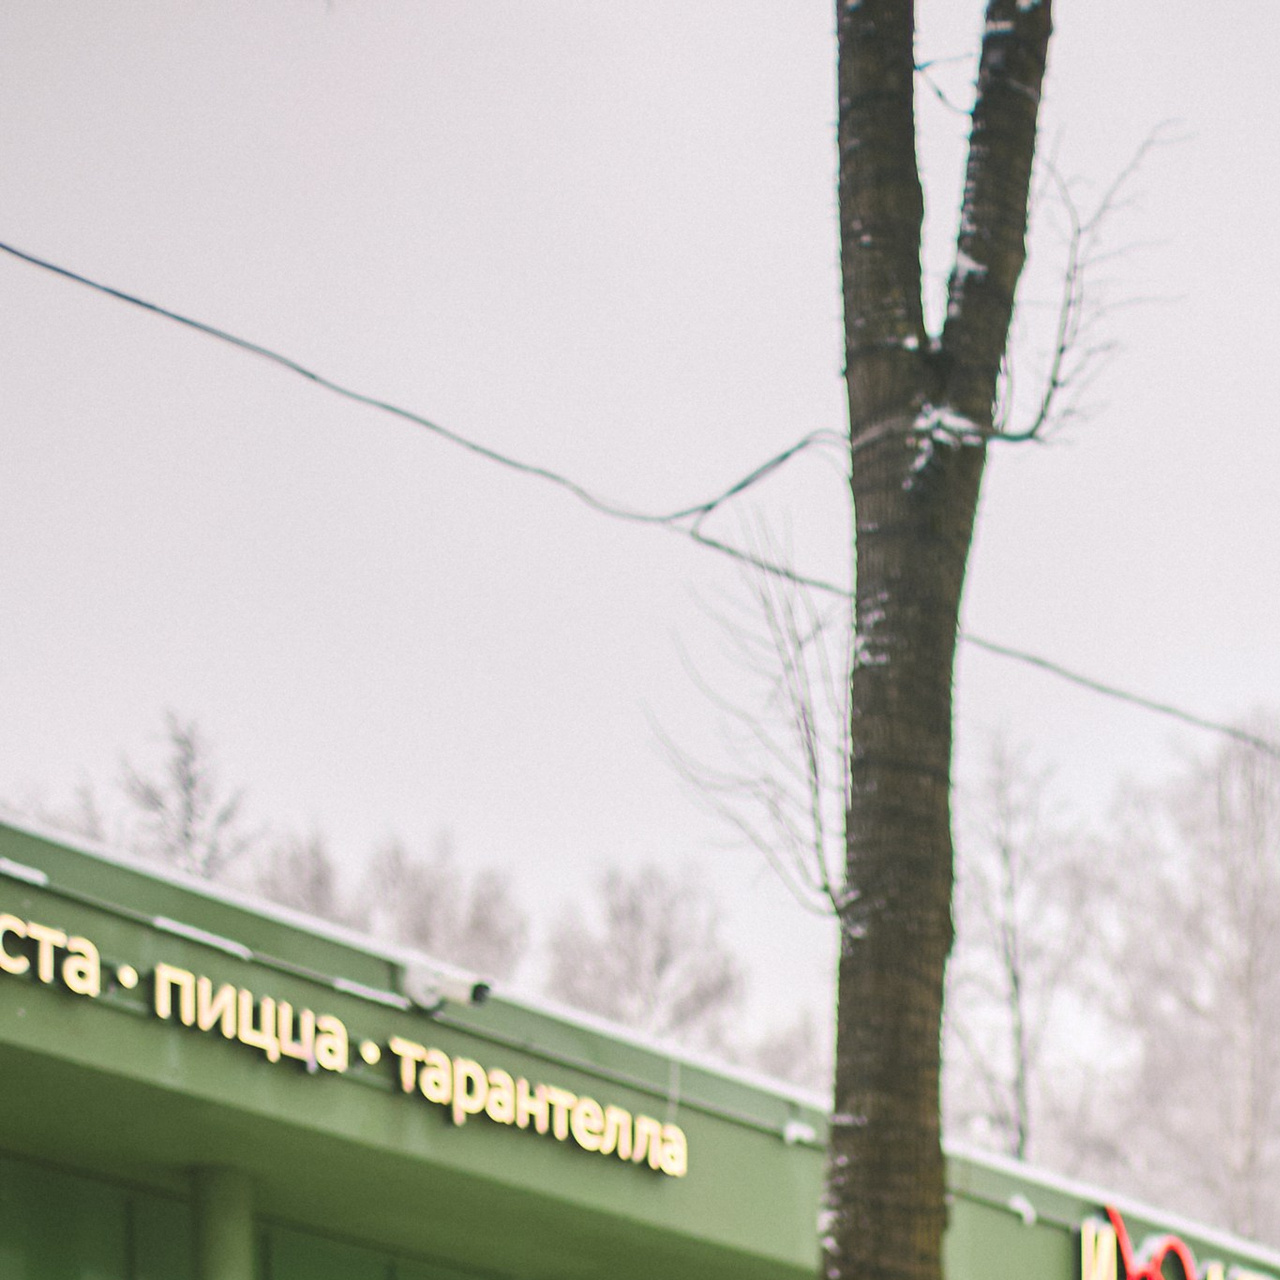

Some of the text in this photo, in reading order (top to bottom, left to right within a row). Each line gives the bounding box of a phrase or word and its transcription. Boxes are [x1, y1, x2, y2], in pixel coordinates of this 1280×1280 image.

[0, 914, 689, 1178] ста пицца тарантелла
